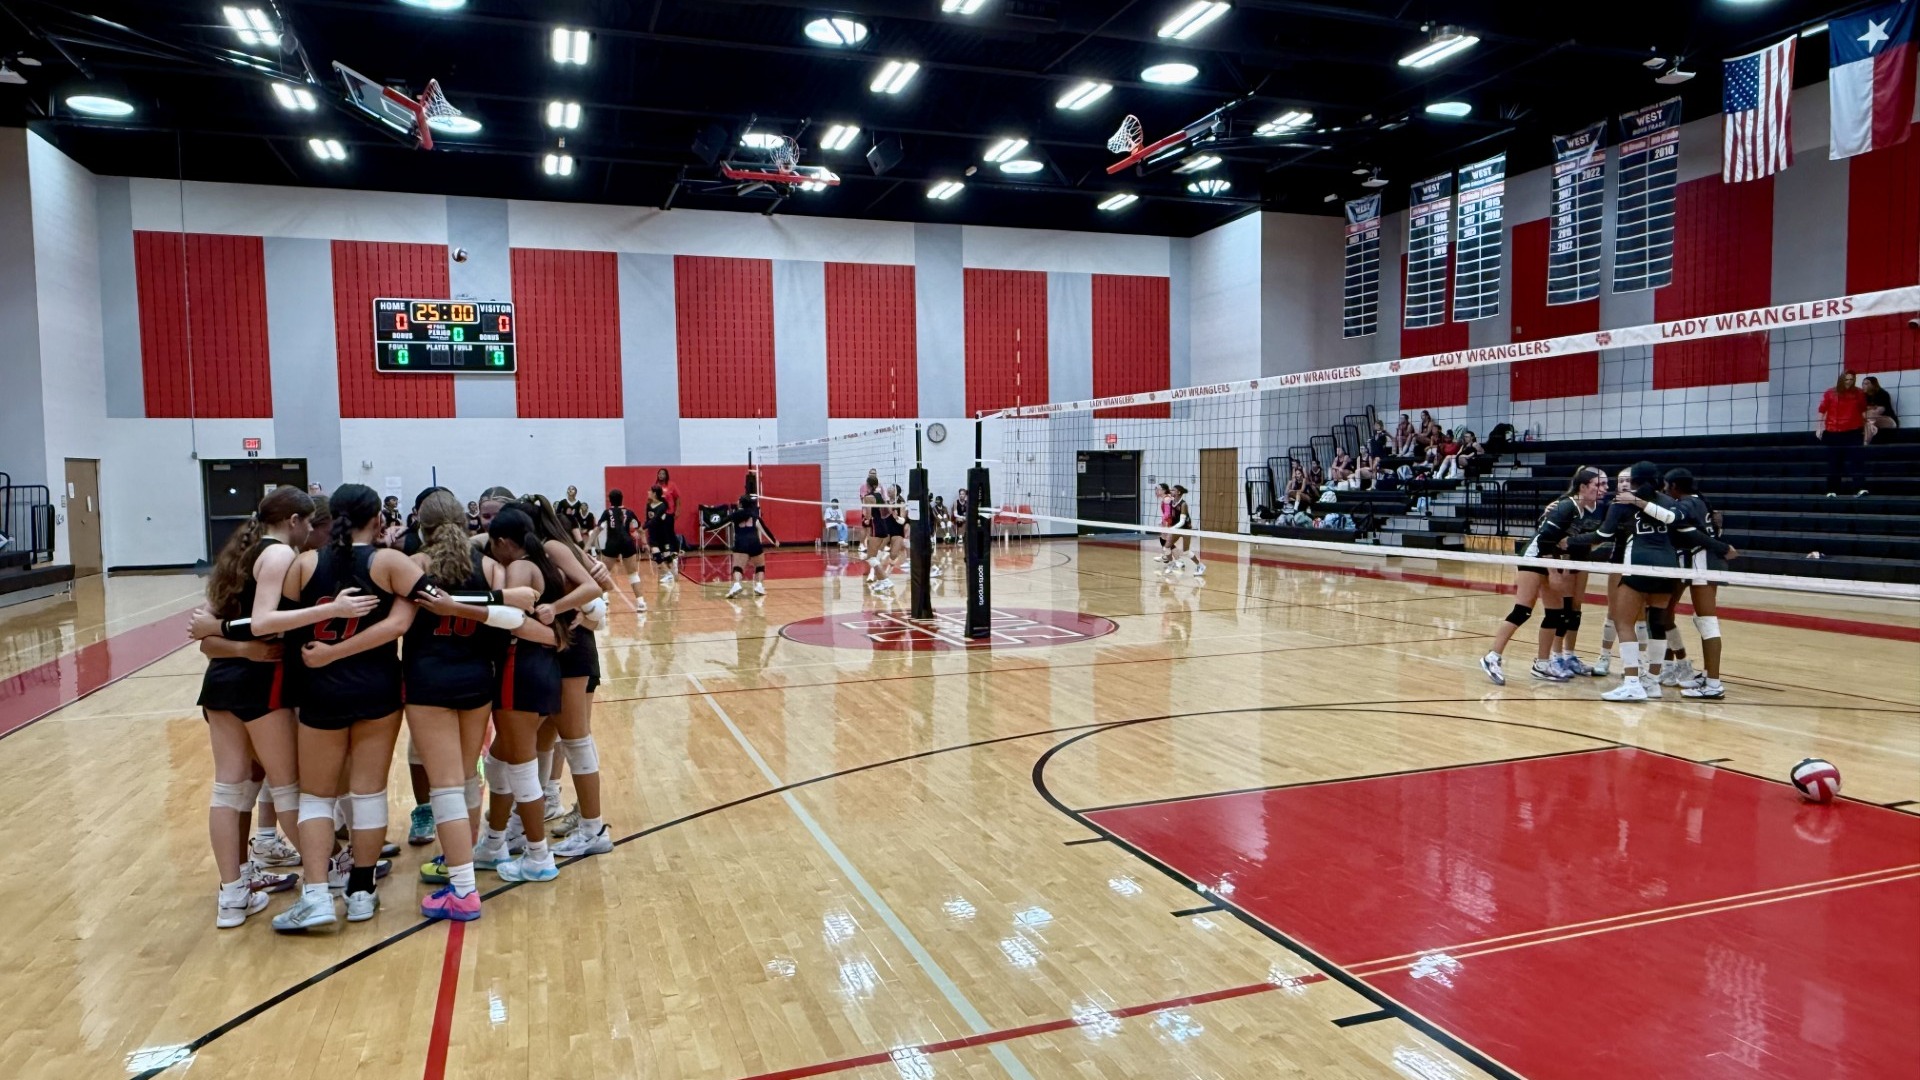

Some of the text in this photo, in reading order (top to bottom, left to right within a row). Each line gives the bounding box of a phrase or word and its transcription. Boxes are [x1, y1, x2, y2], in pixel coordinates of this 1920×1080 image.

[1636, 110, 1663, 126] WEST
[1567, 133, 1590, 149] WEST
[1655, 145, 1675, 159] 2010
[1471, 166, 1492, 180] WEST
[1582, 167, 1601, 180] 2022
[1422, 182, 1441, 194] WEST
[380, 302, 406, 311] HOME
[416, 303, 475, 322] 25:00
[479, 304, 512, 314] VISITOR
[395, 313, 409, 331] 0
[498, 315, 510, 333] 0
[1661, 298, 1854, 339] LADY WRANGLERS
[391, 332, 414, 340] BONUS
[427, 329, 451, 337] PERIOD
[453, 327, 464, 342] 0
[397, 349, 409, 365] 0
[493, 351, 505, 366] 0
[1432, 340, 1551, 368] LADY WRANGLERS
[1280, 366, 1361, 386] LADY WRANGLERS
[1171, 383, 1230, 399] LADY WRANGLERS
